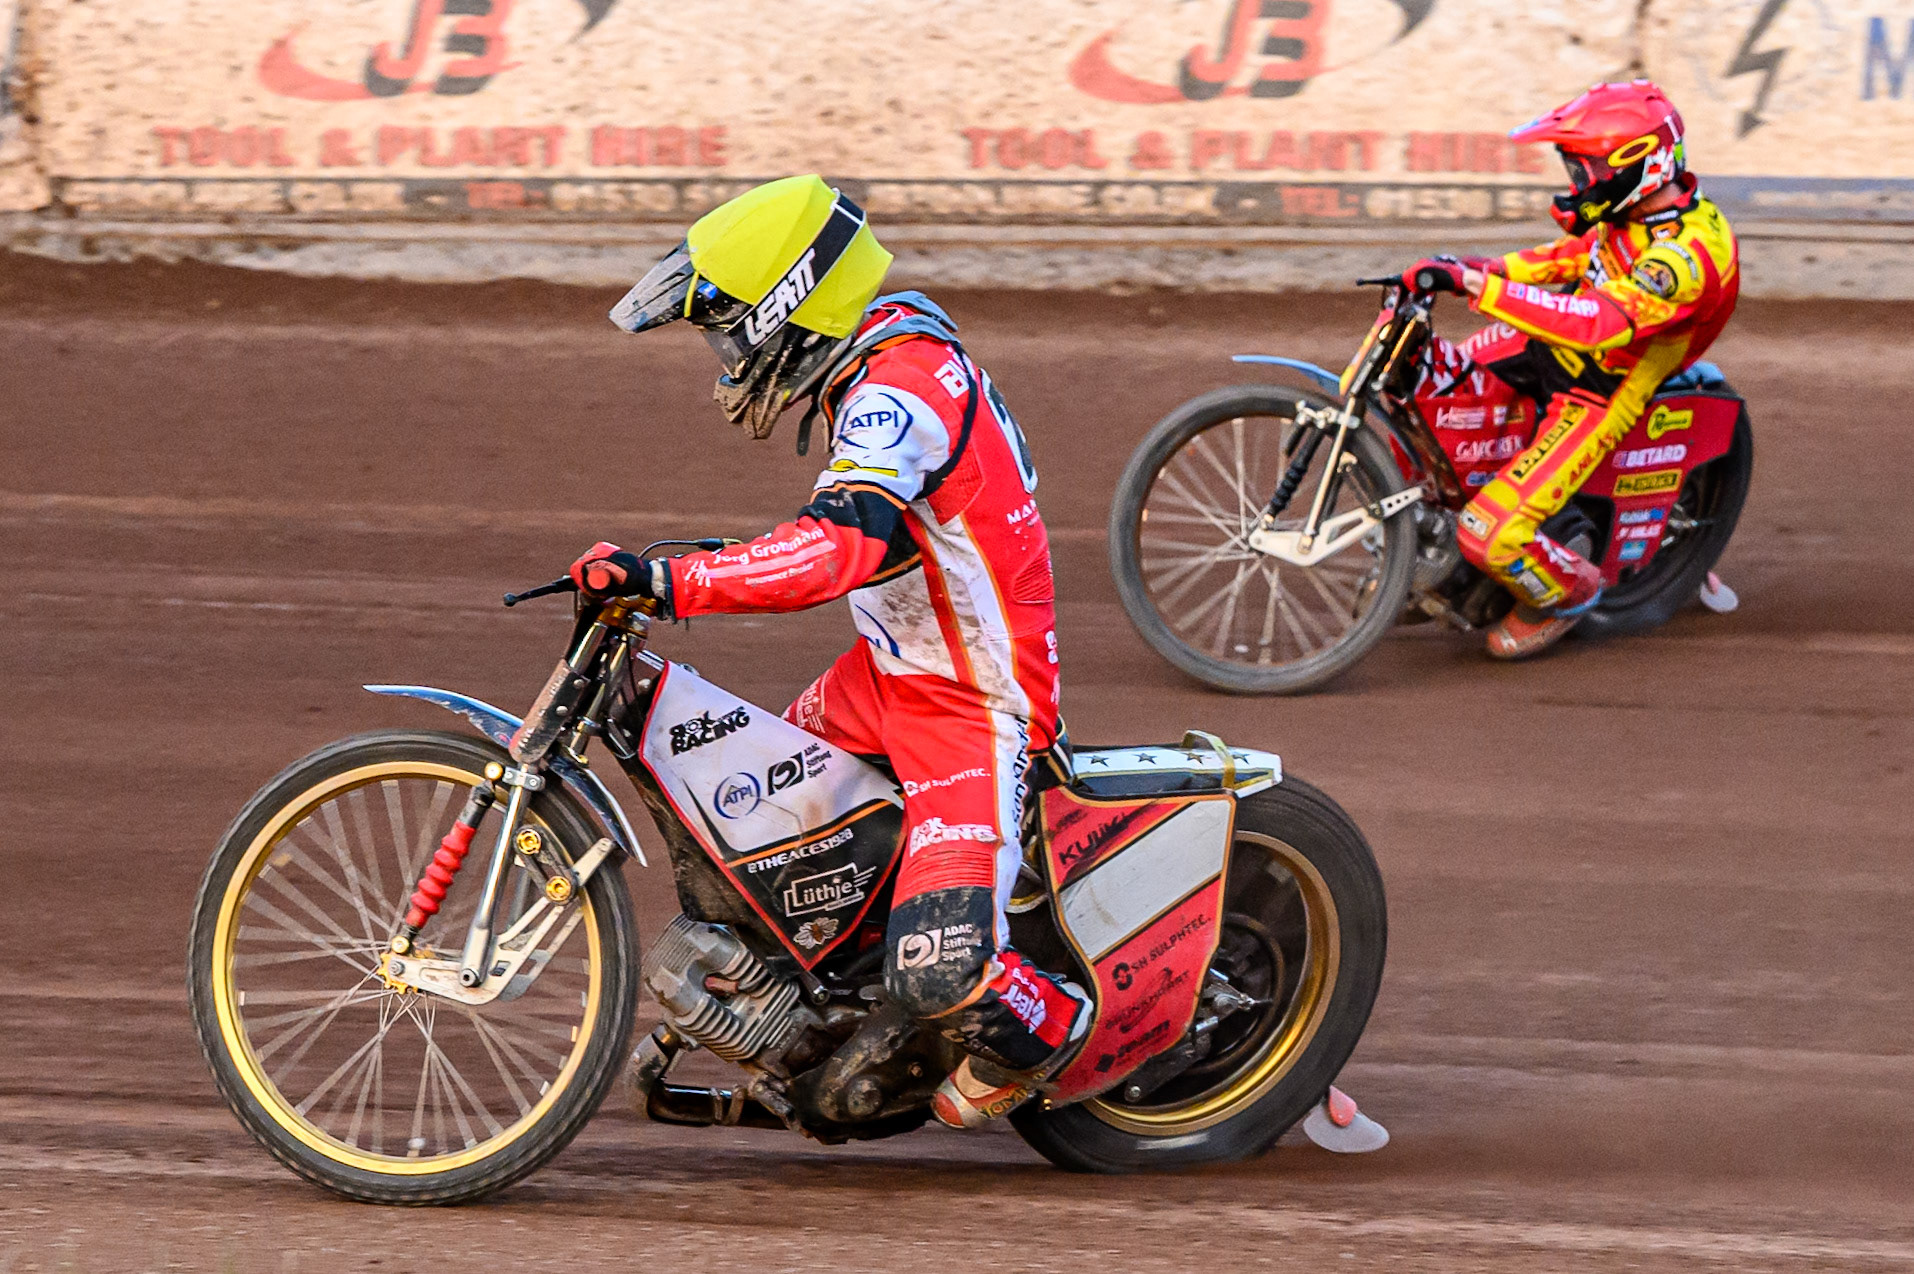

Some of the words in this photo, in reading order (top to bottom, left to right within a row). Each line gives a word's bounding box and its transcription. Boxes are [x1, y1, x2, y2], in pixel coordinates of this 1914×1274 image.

[744, 247, 816, 346] LEATT
[850, 410, 899, 429] ATPI
[671, 711, 750, 757] RACING
[792, 875, 853, 907] Lüthje
[943, 923, 973, 937] ADAC
[941, 946, 972, 962] Sport
